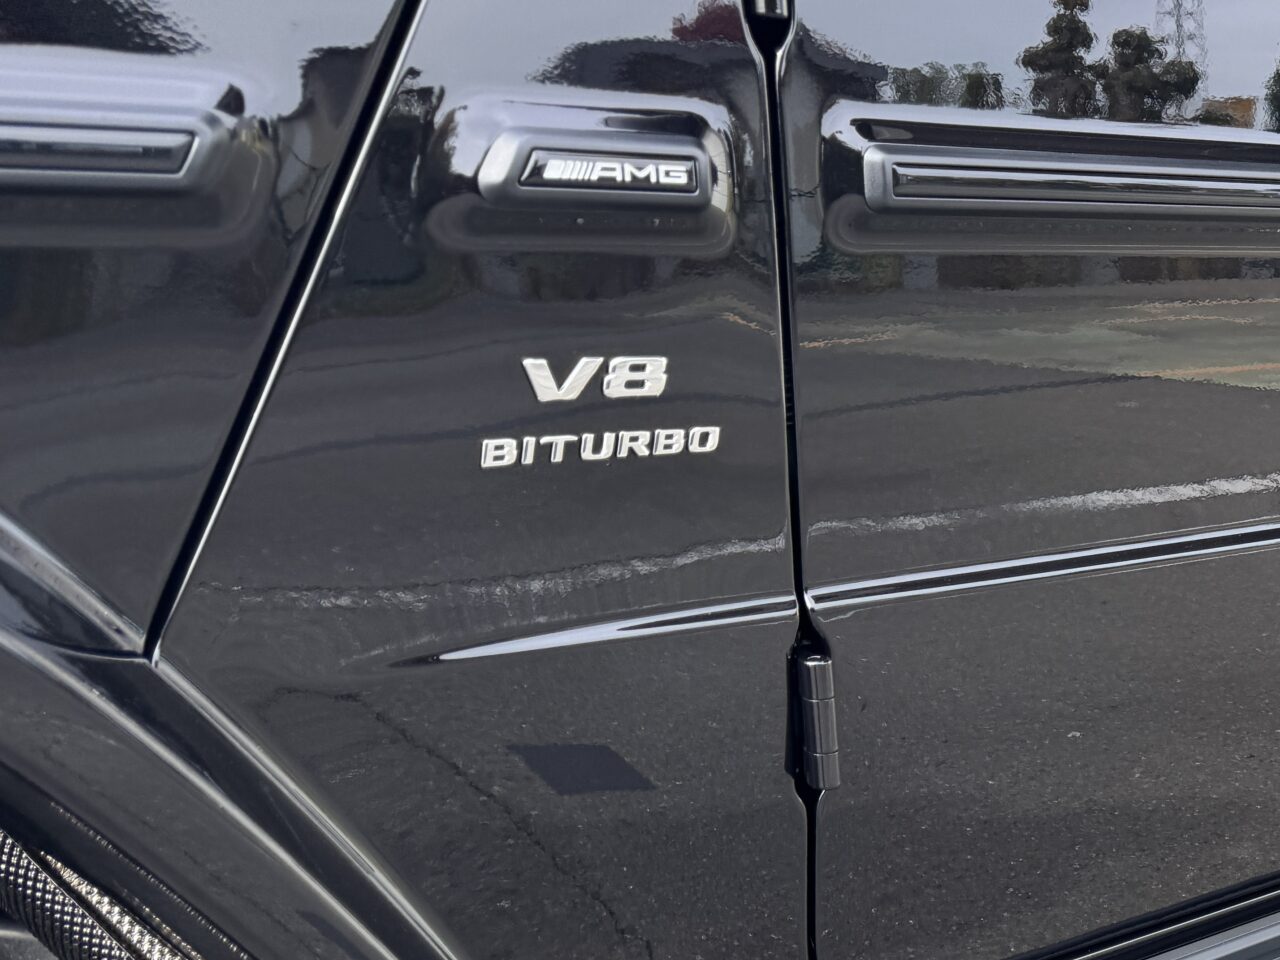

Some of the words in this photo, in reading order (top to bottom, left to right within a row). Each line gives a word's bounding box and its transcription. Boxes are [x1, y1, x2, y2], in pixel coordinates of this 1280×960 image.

[588, 161, 689, 184] AMG
[522, 356, 668, 402] V8
[480, 426, 721, 468] BITURBO
